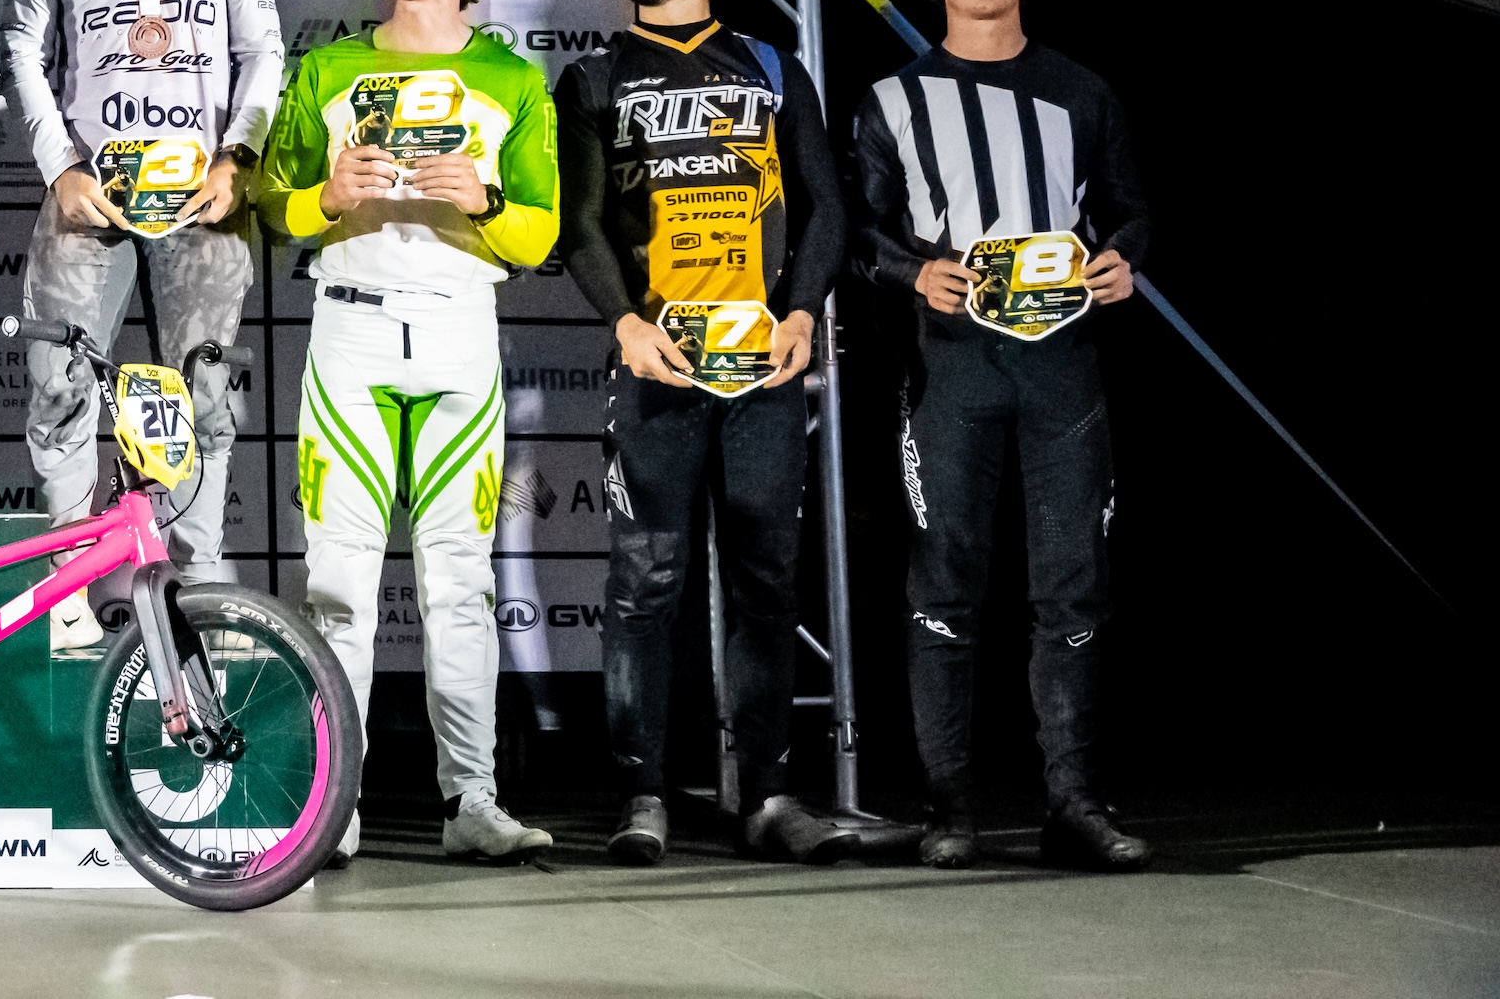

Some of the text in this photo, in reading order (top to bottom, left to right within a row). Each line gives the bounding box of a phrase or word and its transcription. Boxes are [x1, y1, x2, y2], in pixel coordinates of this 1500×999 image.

[159, 49, 214, 68] Gate
[357, 76, 401, 92] 2024
[401, 81, 455, 120] 6
[143, 96, 204, 131] box
[103, 140, 145, 155] 2024
[415, 149, 440, 157] GWM
[145, 145, 197, 184] 3
[645, 155, 739, 179] TANGENT
[665, 191, 748, 206] SHIMANO
[692, 211, 747, 221] TIOGA
[675, 235, 698, 246] 100%
[973, 239, 1016, 256] 2024
[1020, 242, 1074, 284] 8
[668, 305, 709, 318] 2024
[1036, 313, 1062, 321] GWM
[716, 311, 761, 348] 7
[146, 367, 160, 378] box
[504, 368, 606, 391] HIMAN
[100, 380, 112, 406] FLAT
[0, 398, 27, 409] DRE
[141, 399, 180, 439] 217
[547, 604, 603, 628] GW
[266, 618, 283, 633] X
[397, 634, 422, 644] DRE
[130, 670, 233, 823] 3
